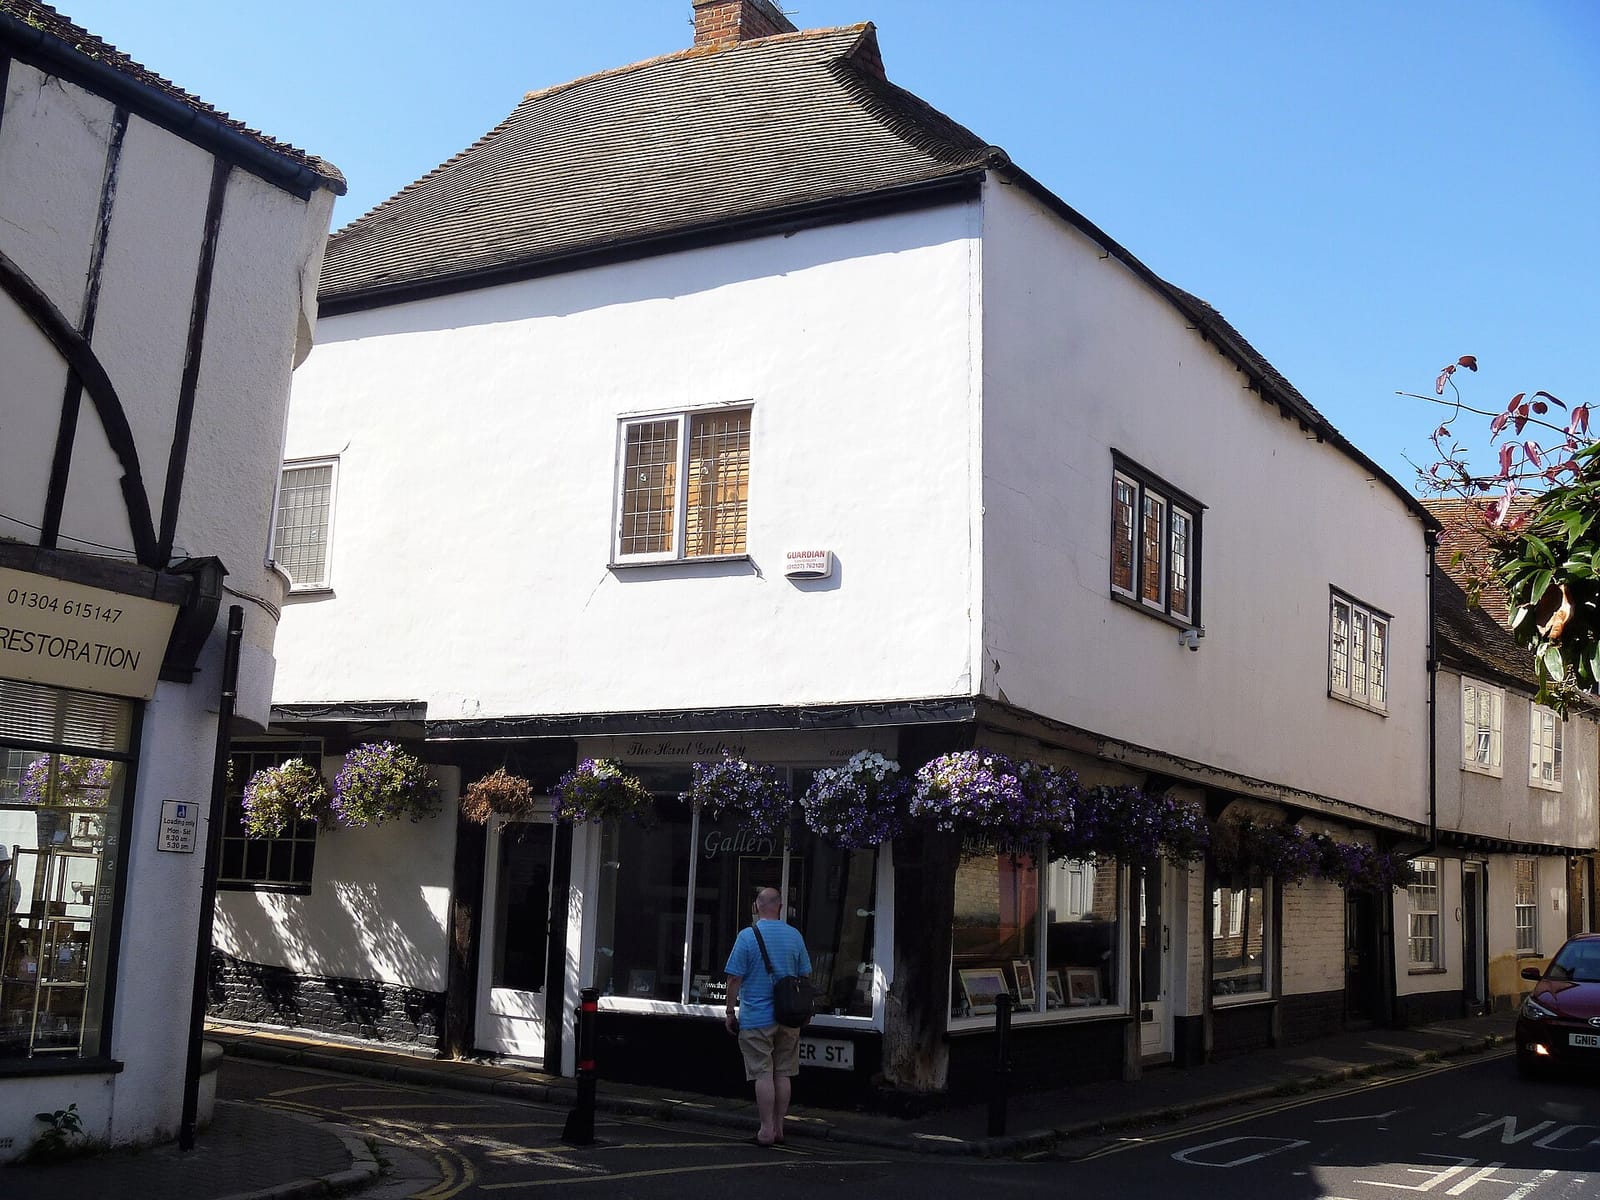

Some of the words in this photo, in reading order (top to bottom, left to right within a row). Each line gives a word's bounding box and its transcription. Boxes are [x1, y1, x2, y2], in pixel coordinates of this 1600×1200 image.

[786, 550, 825, 559] GUARDIAN
[7, 589, 58, 612] 01304
[63, 600, 123, 624] 615147
[0, 627, 141, 671] RESTORATION
[626, 741, 652, 756] The
[695, 740, 747, 757] Gally
[704, 829, 777, 860] Gallery
[1575, 1034, 1598, 1046] GN16
[824, 1045, 849, 1063] ST.
